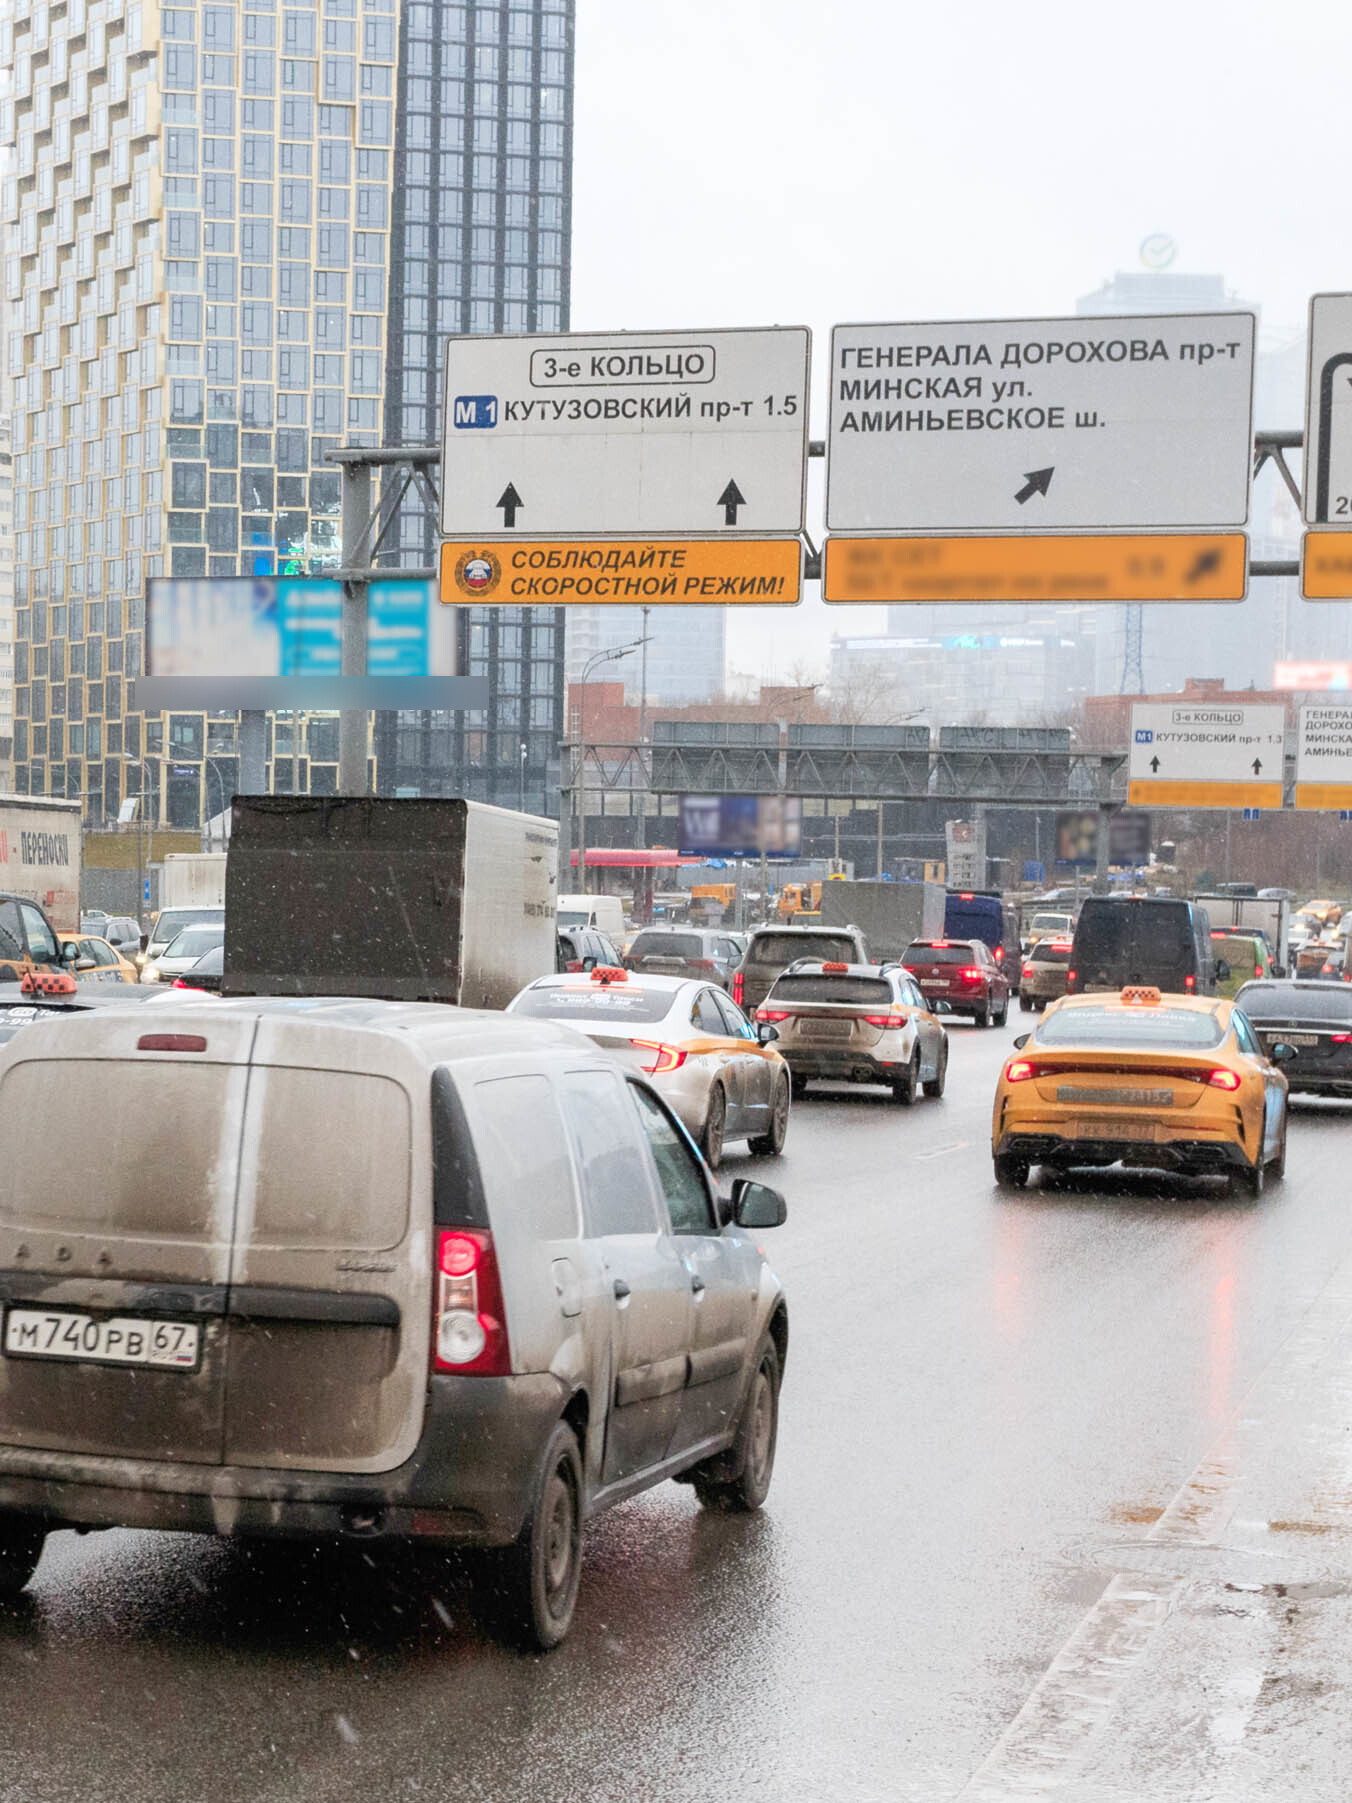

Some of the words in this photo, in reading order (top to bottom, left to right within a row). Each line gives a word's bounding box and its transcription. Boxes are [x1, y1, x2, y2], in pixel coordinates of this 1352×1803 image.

[543, 358, 581, 377] 3-е
[590, 353, 705, 377] КОЛЬЦО
[841, 345, 992, 368] ГЕНЕРАЛА
[1000, 340, 1169, 369] ДОРОХОВА
[1179, 342, 1241, 365] пр-т
[840, 377, 982, 401] МИНСКАЯ
[991, 379, 1032, 403] ул.
[504, 393, 691, 422] КУТУЗОВСКИЙ
[700, 399, 753, 422] пр-т
[765, 395, 797, 416] 1.5
[840, 407, 1065, 433] АМИНЬЕВСКОЕ
[1074, 411, 1106, 429] ш.
[511, 547, 688, 570] СОБЛЮДАЙТЕ
[511, 574, 677, 596] СКОРОСТНОЙ
[683, 576, 785, 596] РЕЖИМ!
[1194, 713, 1242, 723] КОЛЬЦО
[1306, 710, 1352, 719] ГЕНЕРА
[1156, 732, 1236, 743] КУТУЗОВСКИЙ
[21, 832, 69, 866] ПЕРЕНОСКИ
